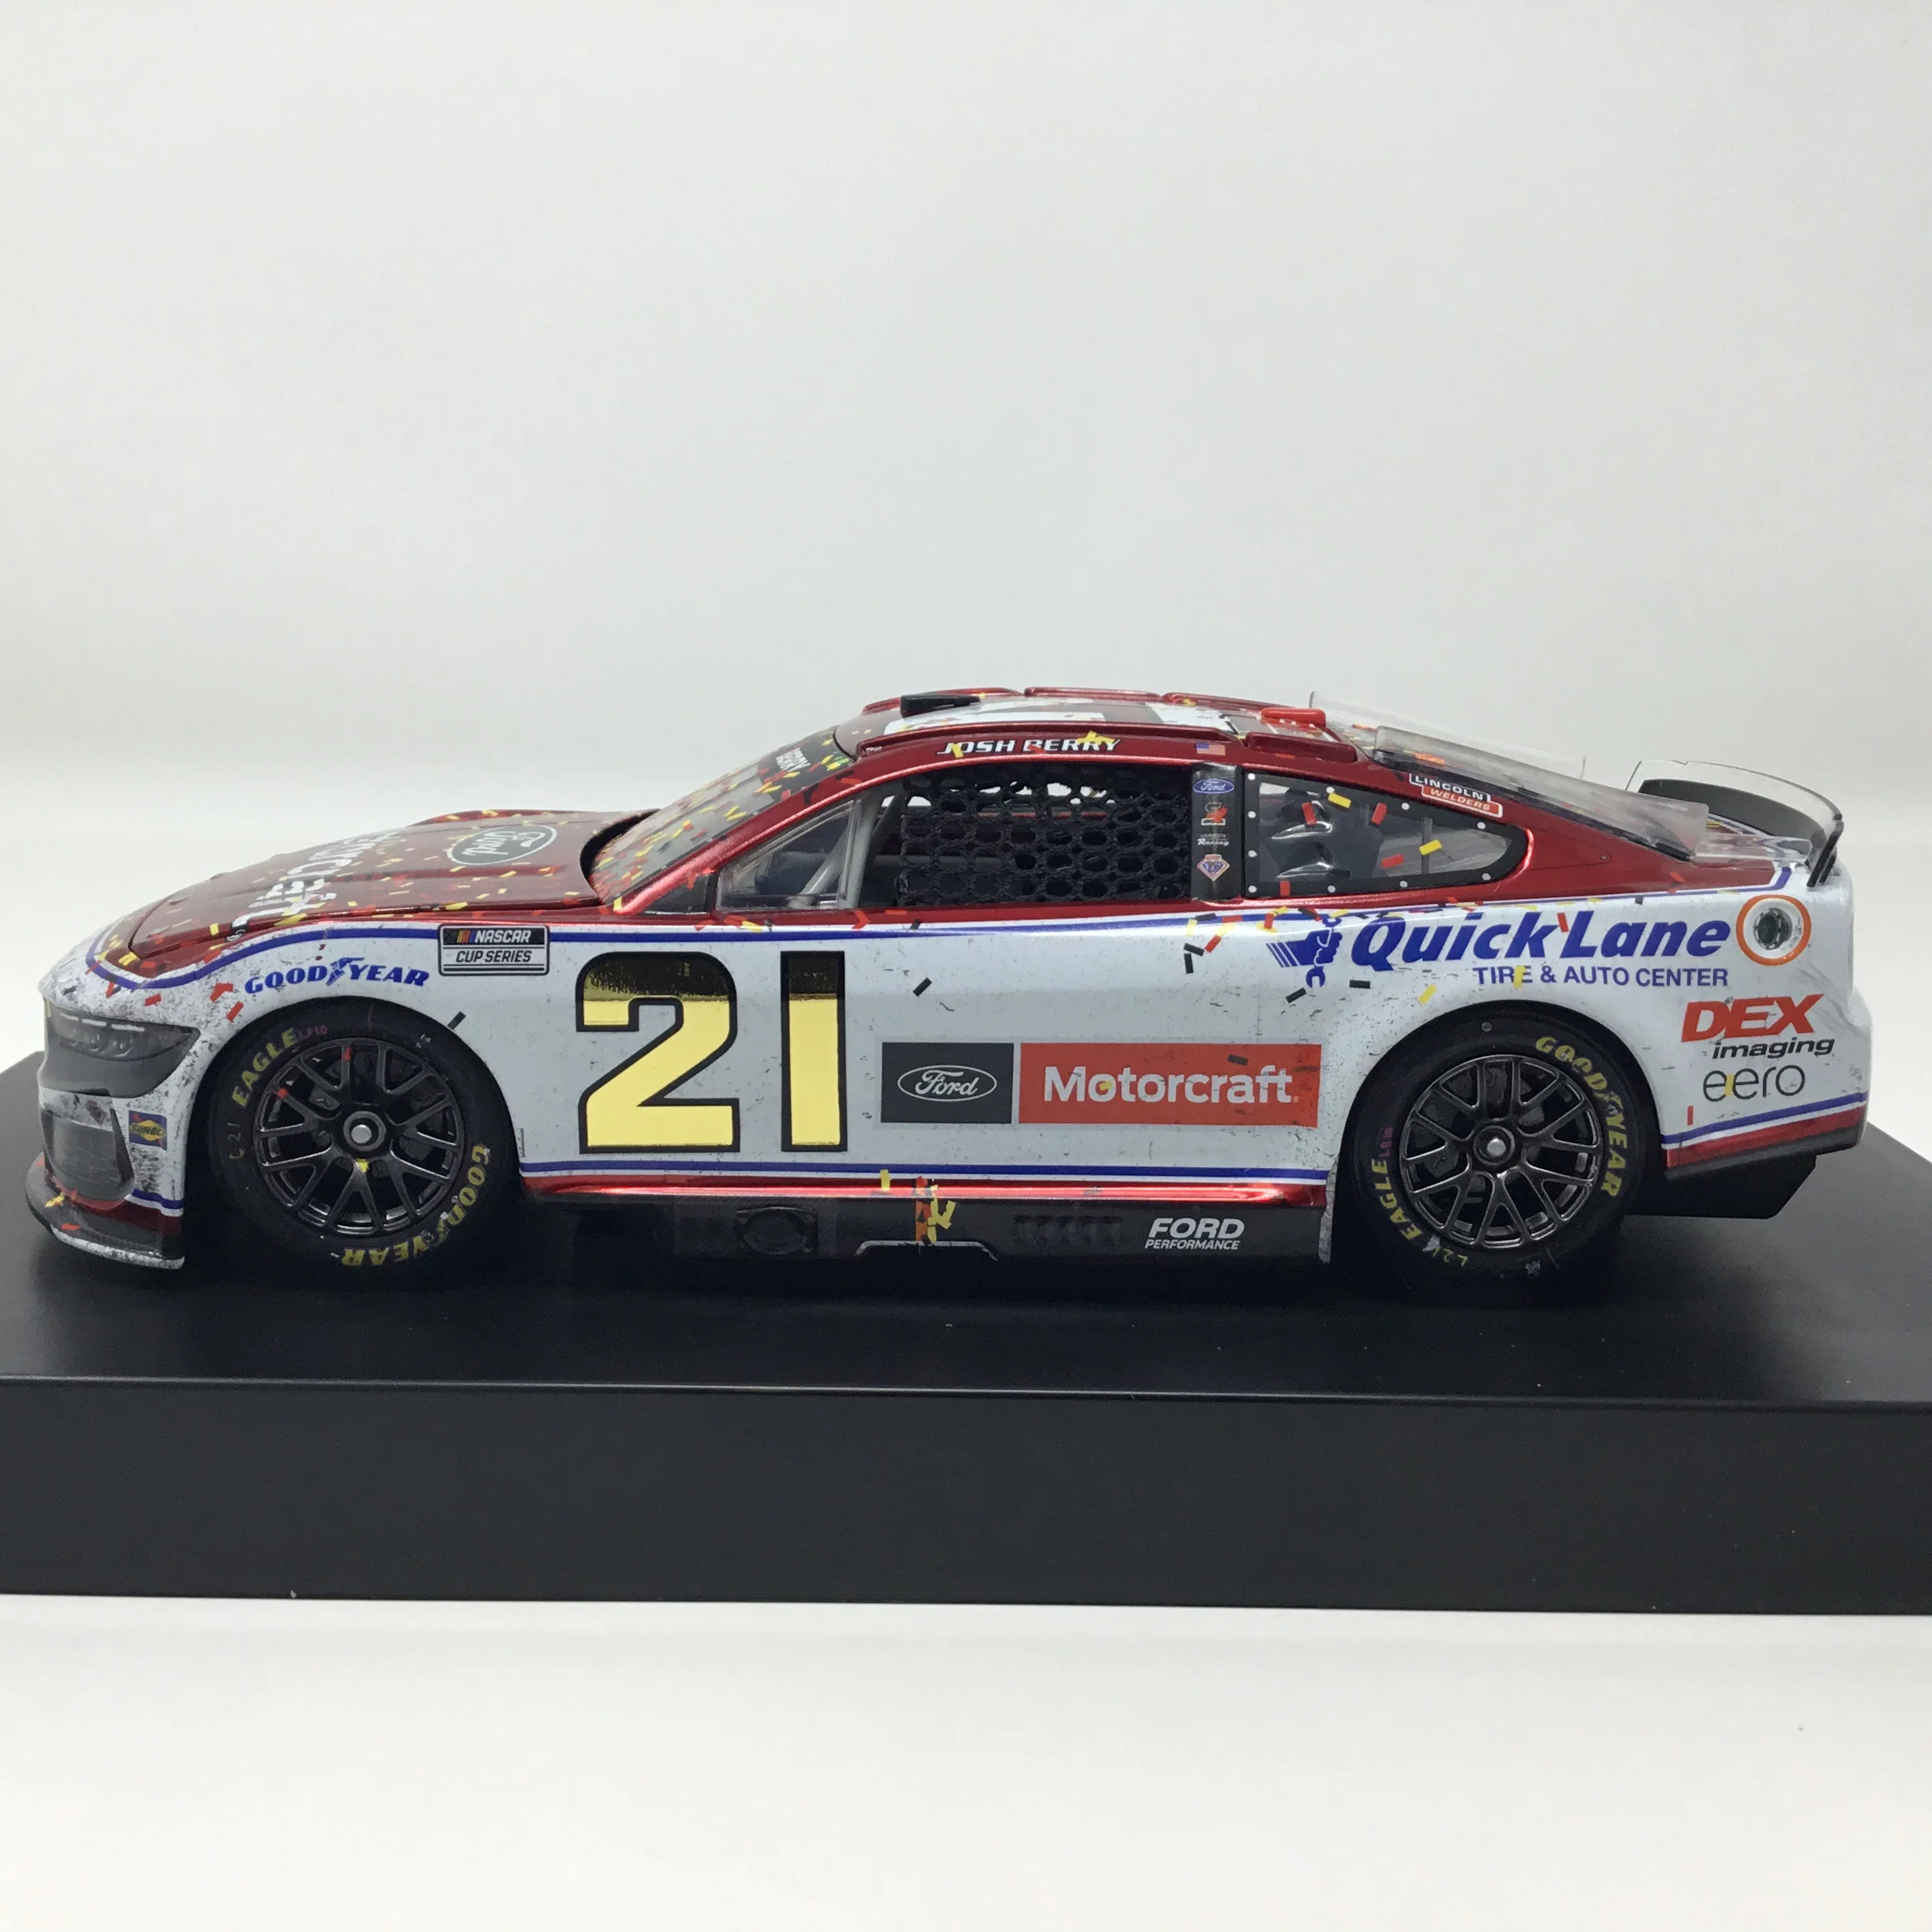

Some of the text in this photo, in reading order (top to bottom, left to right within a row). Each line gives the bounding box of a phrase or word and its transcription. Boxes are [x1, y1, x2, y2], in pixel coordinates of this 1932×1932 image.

[937, 738, 1121, 755] JOSH BERRY
[1415, 775, 1484, 800] LINCOLN
[1430, 788, 1491, 811] WELDERS
[461, 831, 546, 856] Ford
[1196, 837, 1230, 847] Racing
[474, 930, 532, 943] NASCAR
[1350, 910, 1732, 972] Quick Lane
[455, 950, 533, 963] CUP SERIES
[245, 957, 430, 994] GOODYEAR
[1473, 966, 1728, 987] TIRE & AUTO CENTER
[1681, 994, 1825, 1043] DEX
[575, 950, 848, 1155] 21
[1712, 1036, 1836, 1059] imaging
[232, 1028, 295, 1107] EAGLE
[915, 1069, 980, 1095] Ford
[1043, 1065, 1293, 1104] Motorcraft
[1702, 1065, 1806, 1103] eero
[1536, 1036, 1628, 1196] GOODYEAR
[341, 1144, 491, 1266] GOODYEAR
[1371, 1158, 1422, 1240] EAGLE
[1148, 1218, 1245, 1239] FORD
[1144, 1239, 1241, 1250] PERFORMANCE
